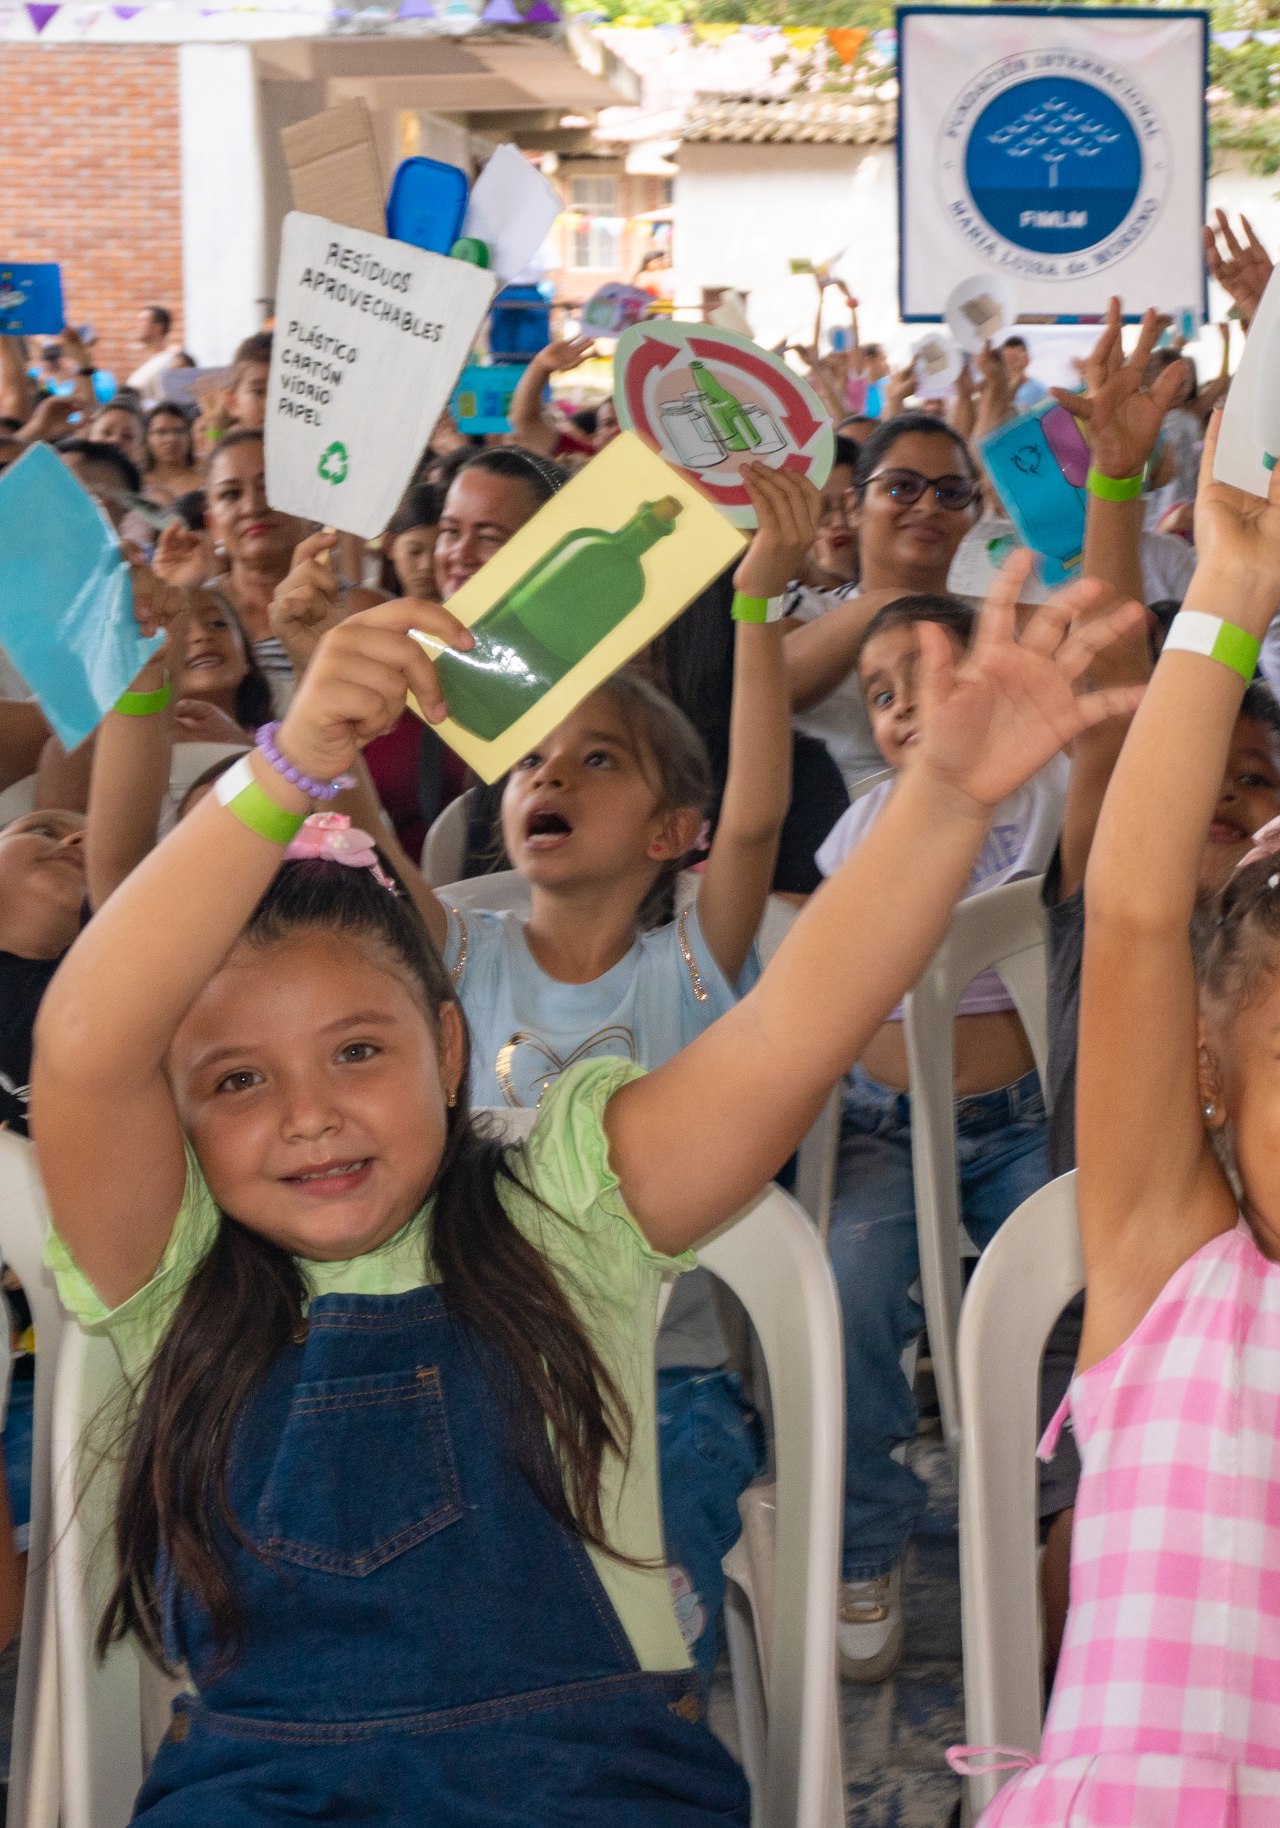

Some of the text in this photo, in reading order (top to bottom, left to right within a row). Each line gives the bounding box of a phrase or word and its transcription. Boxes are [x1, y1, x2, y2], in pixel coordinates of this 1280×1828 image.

[299, 268, 444, 343] APROVECHABLES
[281, 349, 342, 386] CARTÓN
[278, 398, 322, 427] PAPEL
